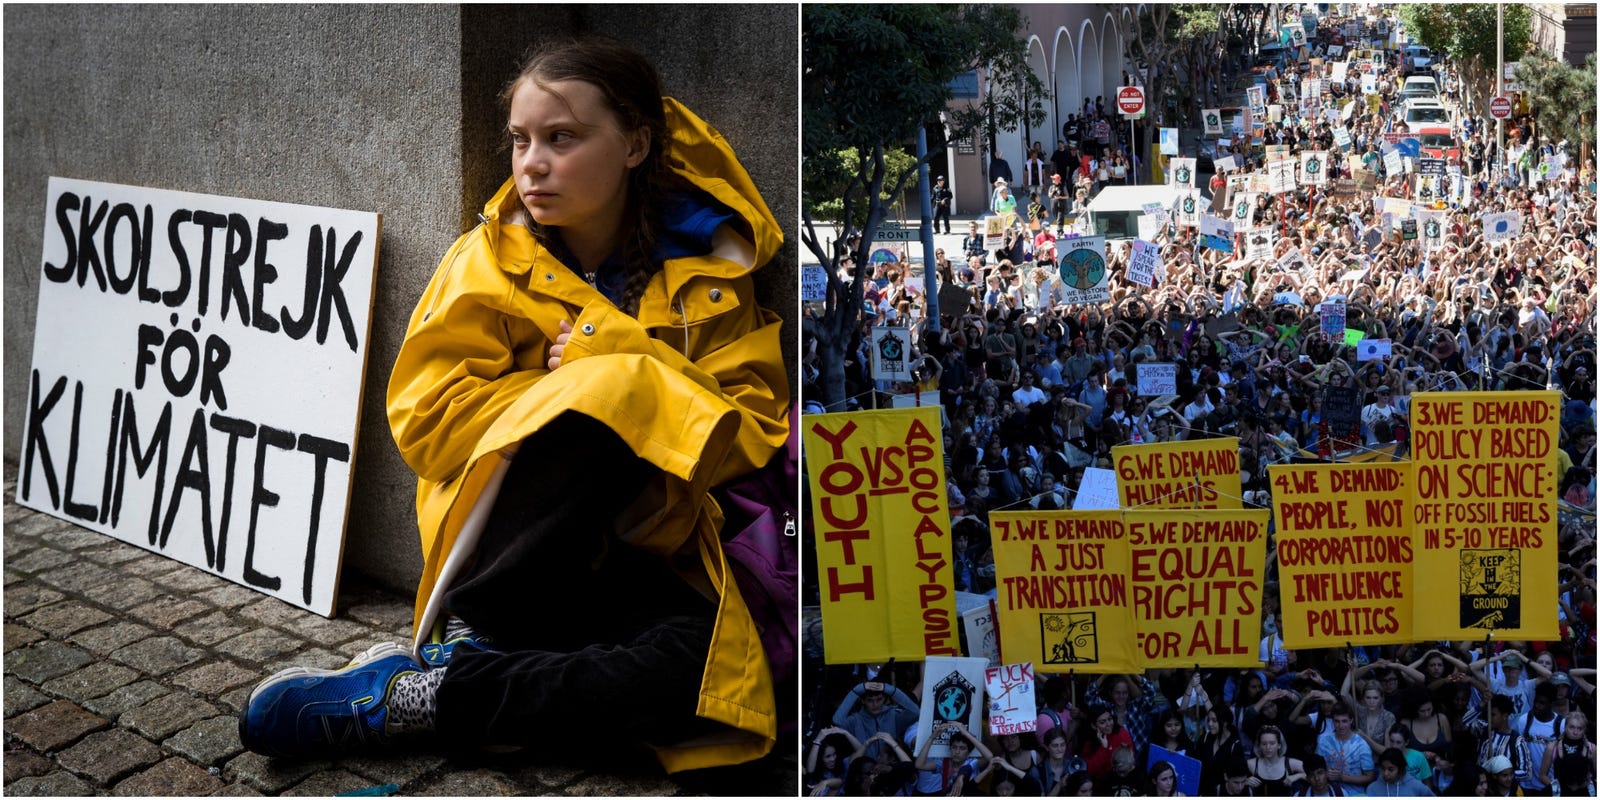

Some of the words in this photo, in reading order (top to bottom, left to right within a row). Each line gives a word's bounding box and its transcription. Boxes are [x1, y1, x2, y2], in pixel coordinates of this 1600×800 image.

[1137, 254, 1155, 266] SPEAK
[1144, 245, 1156, 258] WE
[44, 192, 363, 353] SKOLSTREJK
[136, 313, 231, 410] FÖR
[1417, 402, 1462, 426] 3.WE
[1474, 401, 1555, 424] DEMAND:
[1415, 429, 1482, 460] POLICY
[1491, 428, 1550, 459] BASED
[1118, 454, 1165, 481] 6.WE
[1169, 449, 1239, 479] DEMAND:
[22, 369, 349, 605] KLIMATET
[1125, 481, 1218, 507] HUMANS
[1275, 471, 1317, 494] 4.WE
[1331, 468, 1404, 493] DEMAND:
[1418, 465, 1448, 499] ON
[1457, 464, 1553, 498] SCIENCE:
[1281, 501, 1357, 530] PEOPLE,
[1367, 500, 1403, 527] NOT
[1415, 505, 1440, 523] OFF
[1446, 503, 1497, 523] FOSSIL
[1503, 503, 1550, 523] FUELS
[811, 420, 875, 602] YOUTH
[861, 446, 905, 488] VS
[905, 418, 958, 656] APOCALYPSE
[995, 520, 1049, 541] 7.WE
[1129, 522, 1178, 545] 5.WE
[1182, 521, 1264, 543] DEMAND:
[1425, 528, 1439, 549] IN
[1445, 528, 1481, 548] 5-10
[1488, 527, 1543, 548] YEARS
[1031, 544, 1046, 571] A
[1055, 544, 1105, 571] JUST
[1132, 546, 1253, 582] EQUAL
[1279, 536, 1413, 566] CORPORATIONS
[1480, 556, 1504, 567] KEEP
[1003, 574, 1127, 610] TRANSITION
[1134, 581, 1258, 620] RIGHTS
[1293, 571, 1403, 602] INFLUENCE
[1472, 597, 1508, 609] GROUND
[1307, 606, 1399, 637] POLITICS
[1187, 619, 1248, 656] ALL
[985, 661, 1034, 684] FUCK
